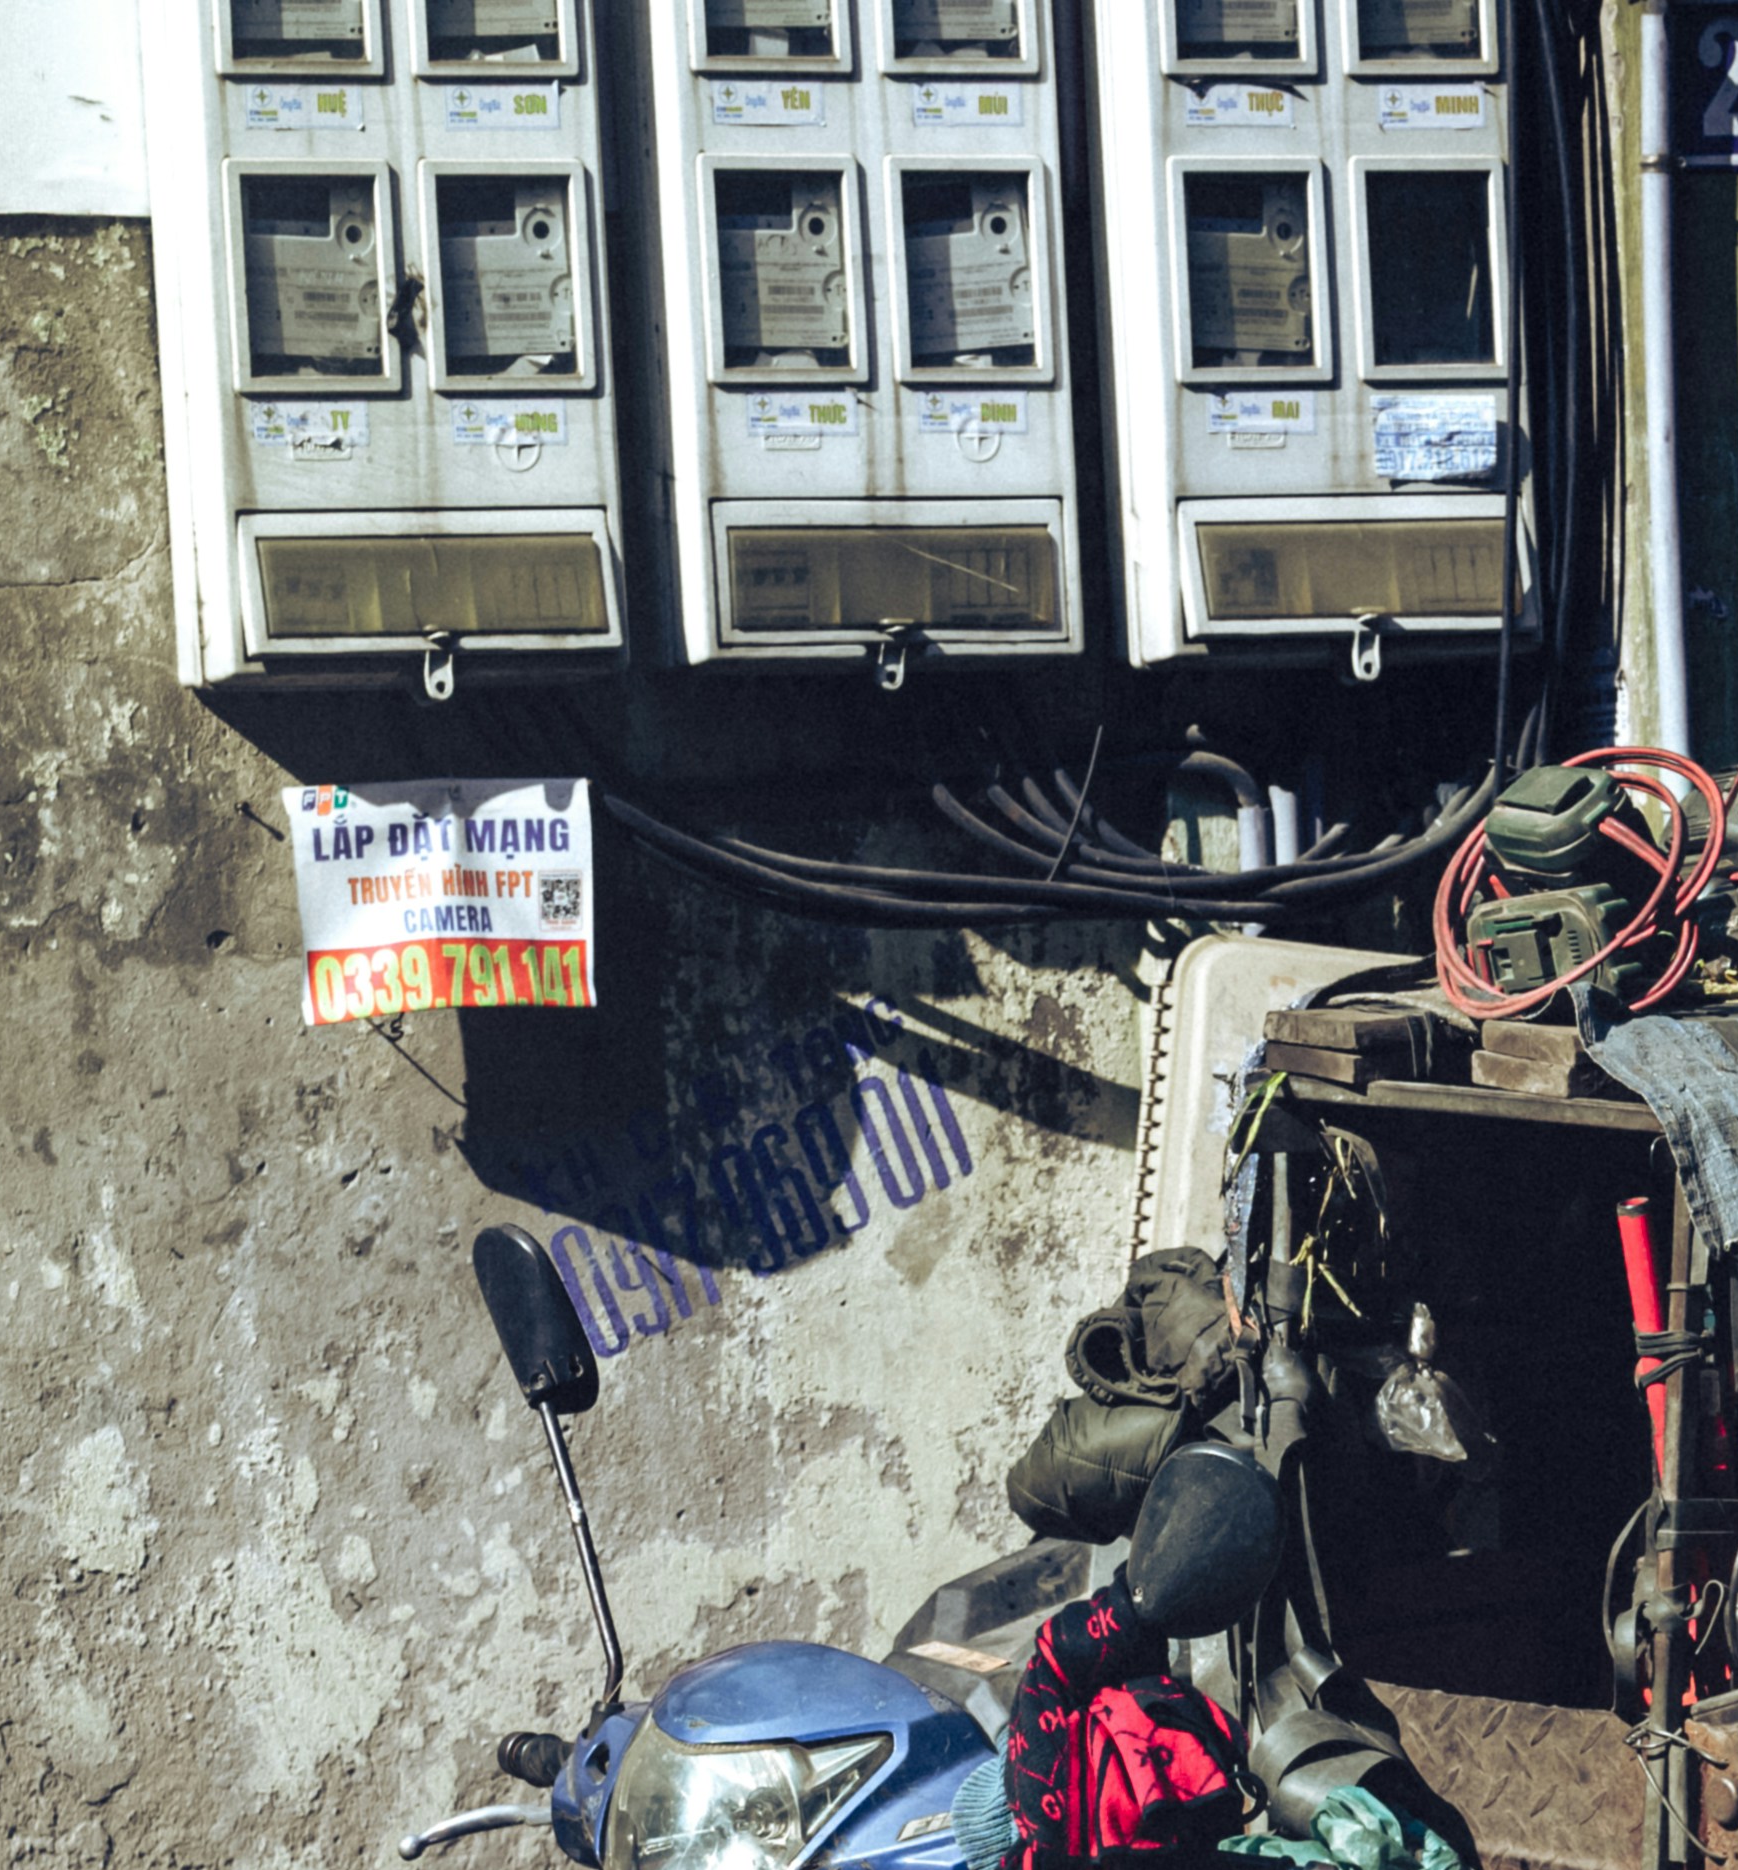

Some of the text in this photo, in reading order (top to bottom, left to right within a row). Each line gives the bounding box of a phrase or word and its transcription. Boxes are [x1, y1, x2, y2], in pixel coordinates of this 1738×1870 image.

[312, 811, 571, 862] LẮP ĐẶT MẠNG
[442, 863, 490, 898] HÌNH
[495, 871, 534, 898] FPT
[404, 905, 493, 934] CAMERA
[314, 943, 586, 1022] 0339.791.141
